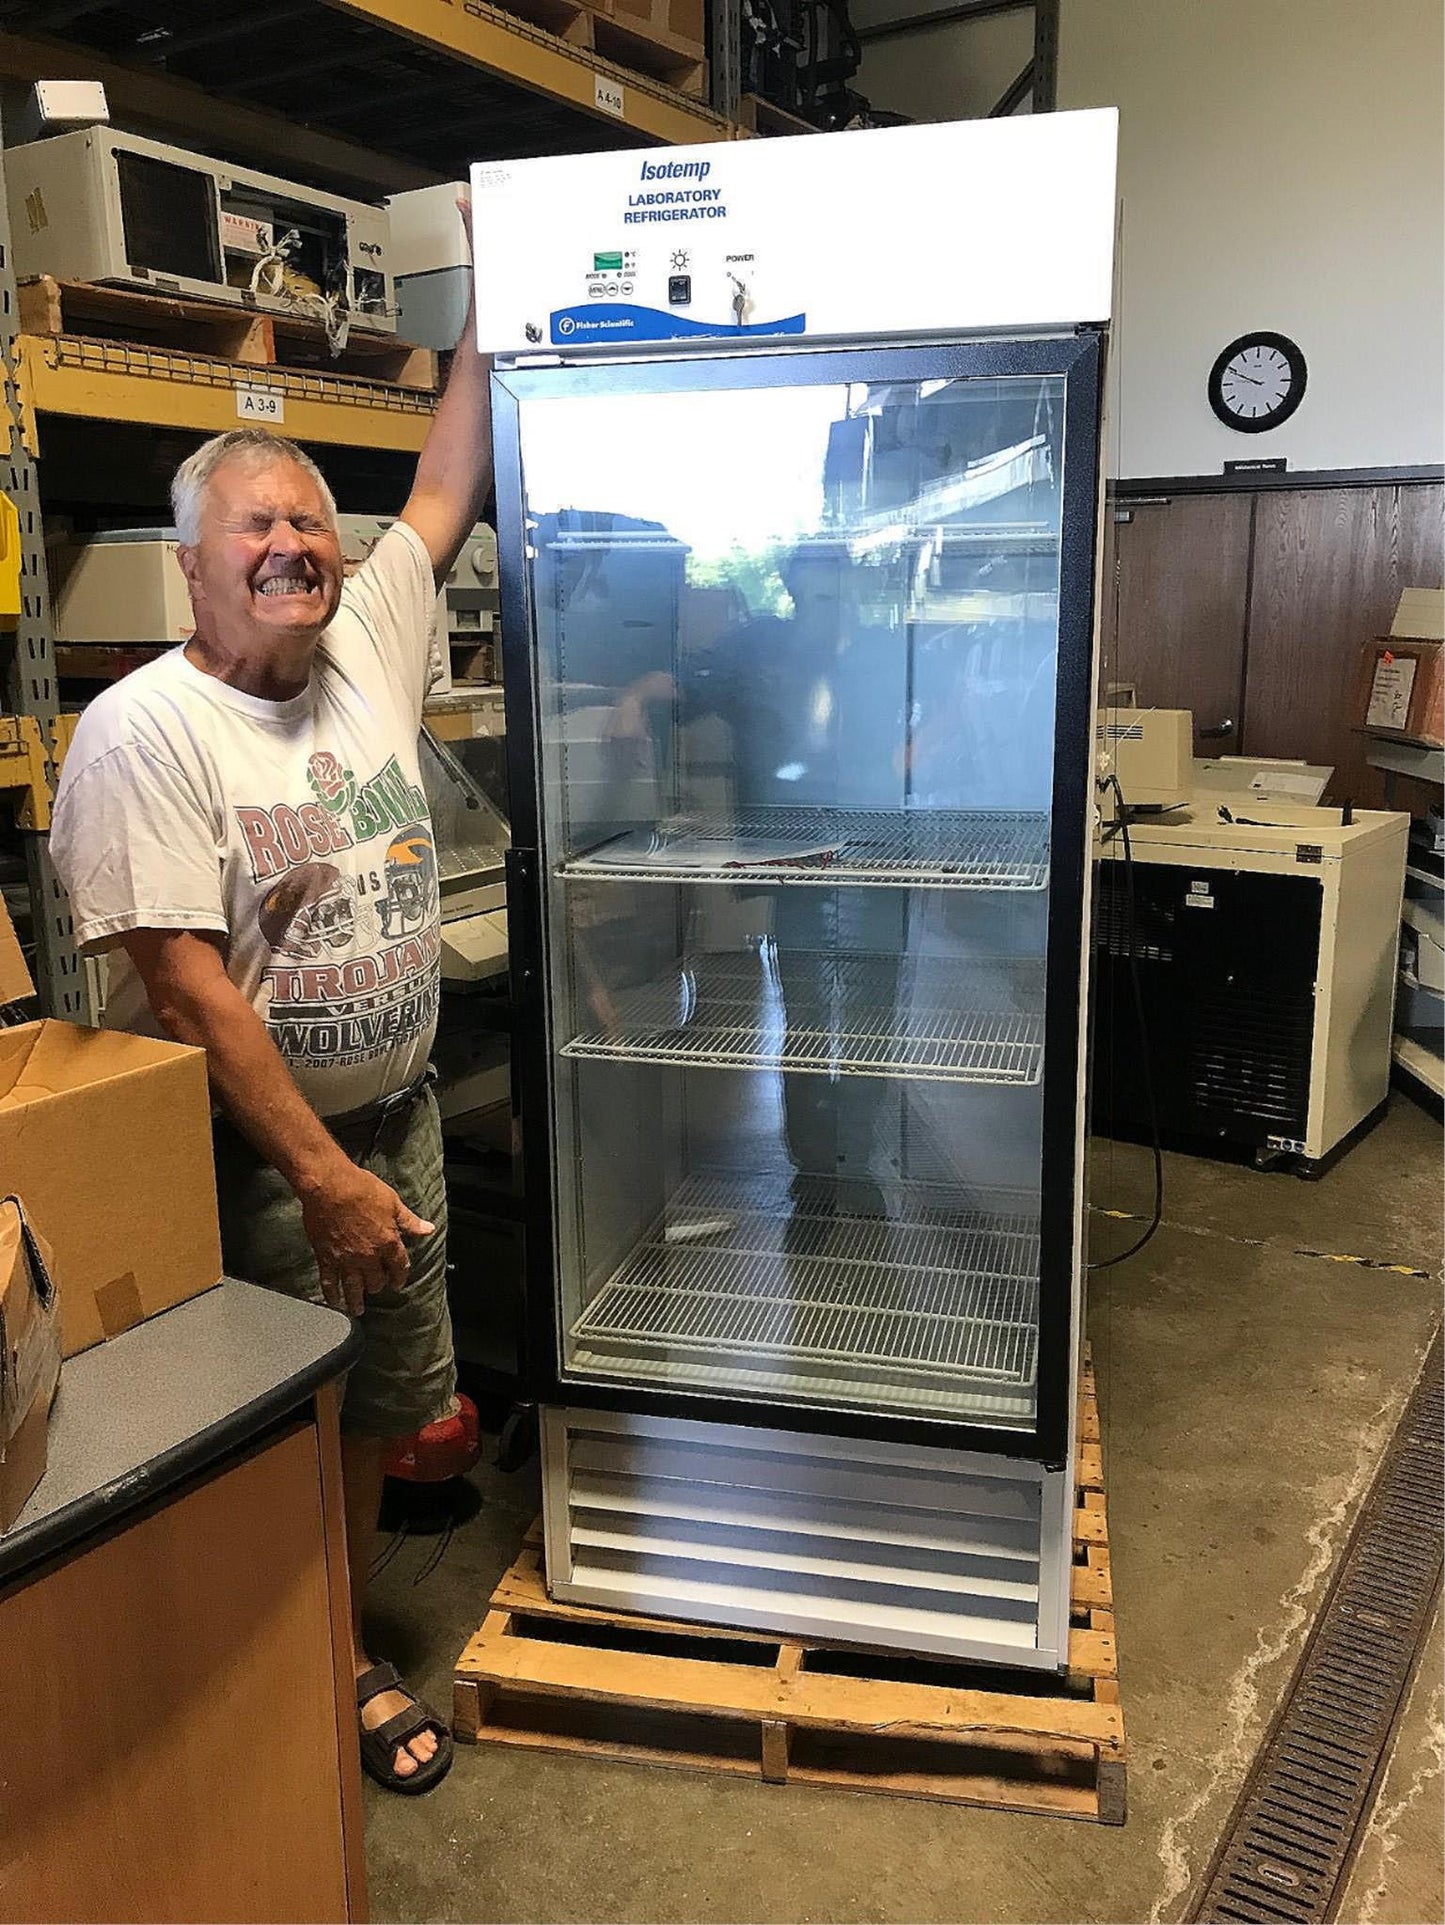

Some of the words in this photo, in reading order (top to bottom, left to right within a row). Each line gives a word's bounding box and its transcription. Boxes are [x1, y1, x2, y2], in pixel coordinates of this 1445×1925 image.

[597, 89, 604, 101] A
[605, 93, 622, 109] 4-10
[640, 161, 711, 182] Isotemp
[628, 188, 722, 206] LABORATORY
[224, 215, 261, 230] WARNIN
[624, 206, 727, 223] REFRIGERATOR
[725, 254, 755, 262] POWER
[576, 321, 599, 330] Fisher
[600, 319, 635, 329] Scientific
[245, 396, 255, 410] A
[258, 398, 276, 413] 3-9
[235, 800, 353, 884] ROSE
[349, 755, 431, 846] BOWL
[262, 928, 439, 1004] TROJAN
[266, 975, 438, 1057] WOLVERINE
